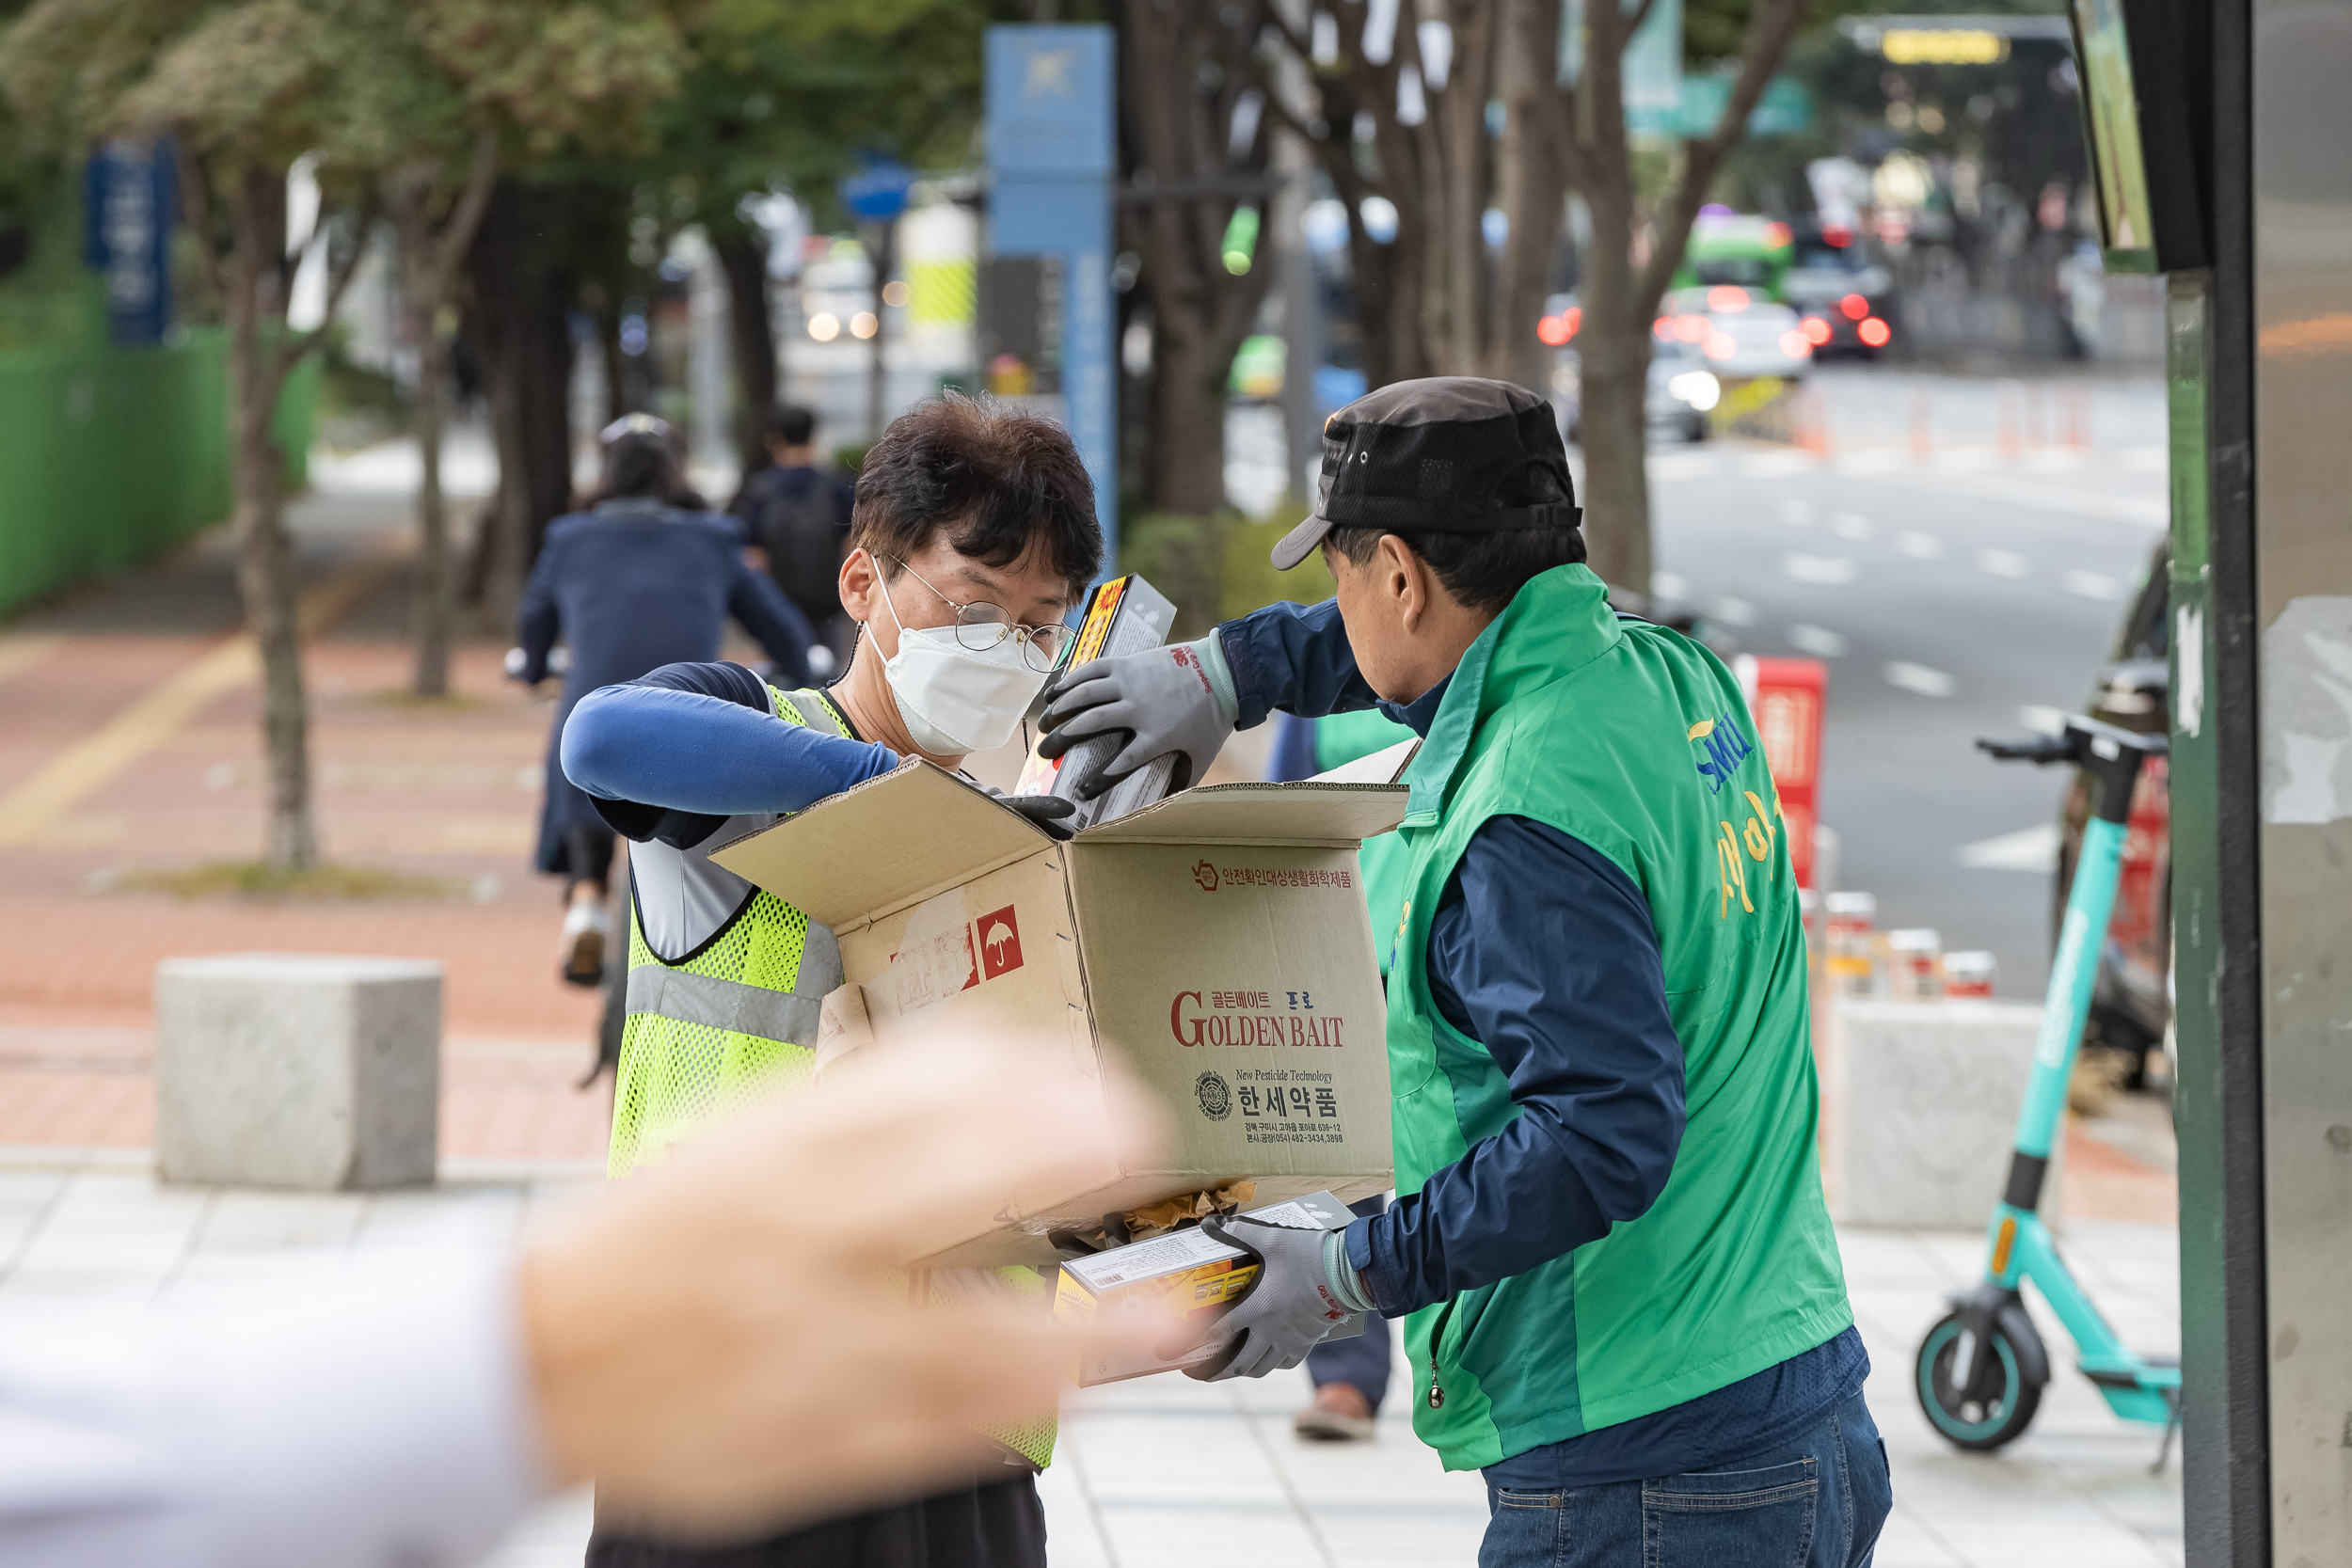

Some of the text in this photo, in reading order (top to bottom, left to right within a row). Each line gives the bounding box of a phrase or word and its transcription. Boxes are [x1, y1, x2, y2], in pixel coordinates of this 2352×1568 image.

[1197, 669, 1213, 694] Super
[1696, 712, 1753, 795] SMU
[1717, 759, 1785, 920] 새마
[1223, 868, 1351, 889] 안전확인대상생활화학제품
[1212, 990, 1314, 1010] 골든베이트 프로
[1170, 990, 1343, 1047] GOLDEN BAIT
[1236, 1069, 1332, 1084] New Pesticide Technology
[1238, 1085, 1337, 1117] 한세약품
[1245, 1122, 1258, 1132] 경북
[1259, 1122, 1278, 1132] 구미시
[1279, 1123, 1297, 1132] 고아읍
[1317, 1284, 1329, 1299] 100
